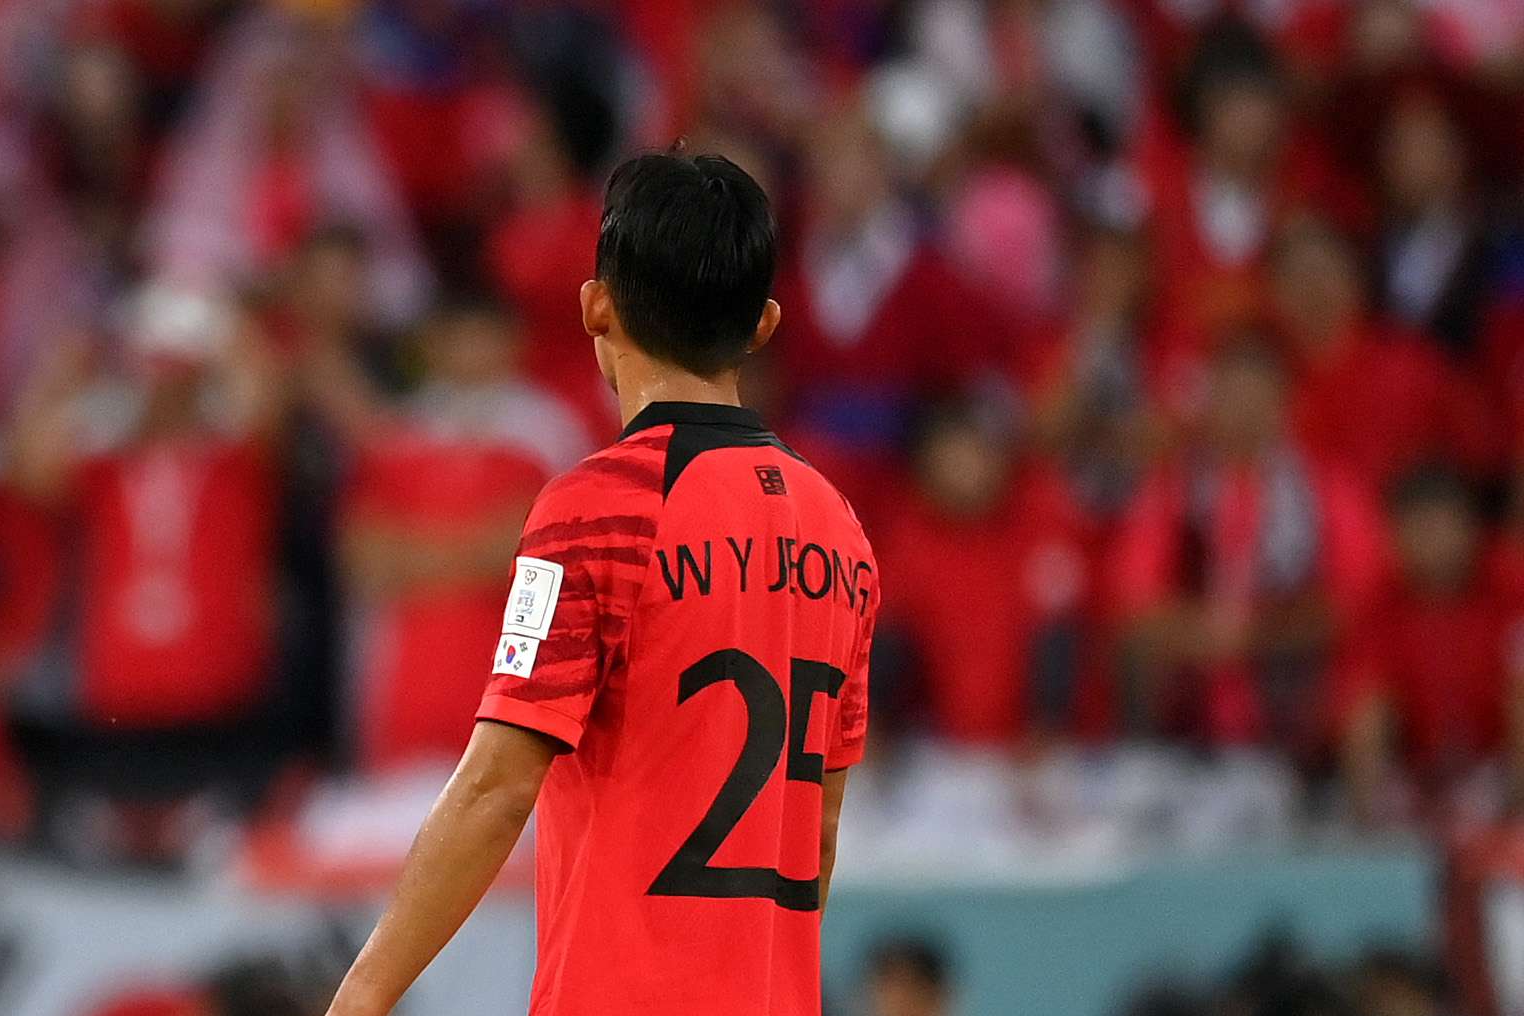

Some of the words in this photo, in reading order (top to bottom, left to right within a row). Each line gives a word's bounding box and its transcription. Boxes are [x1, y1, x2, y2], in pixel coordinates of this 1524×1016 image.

[656, 540, 712, 601] W
[725, 536, 754, 593] Y
[768, 535, 873, 618] JEONG
[644, 648, 847, 911] 25
